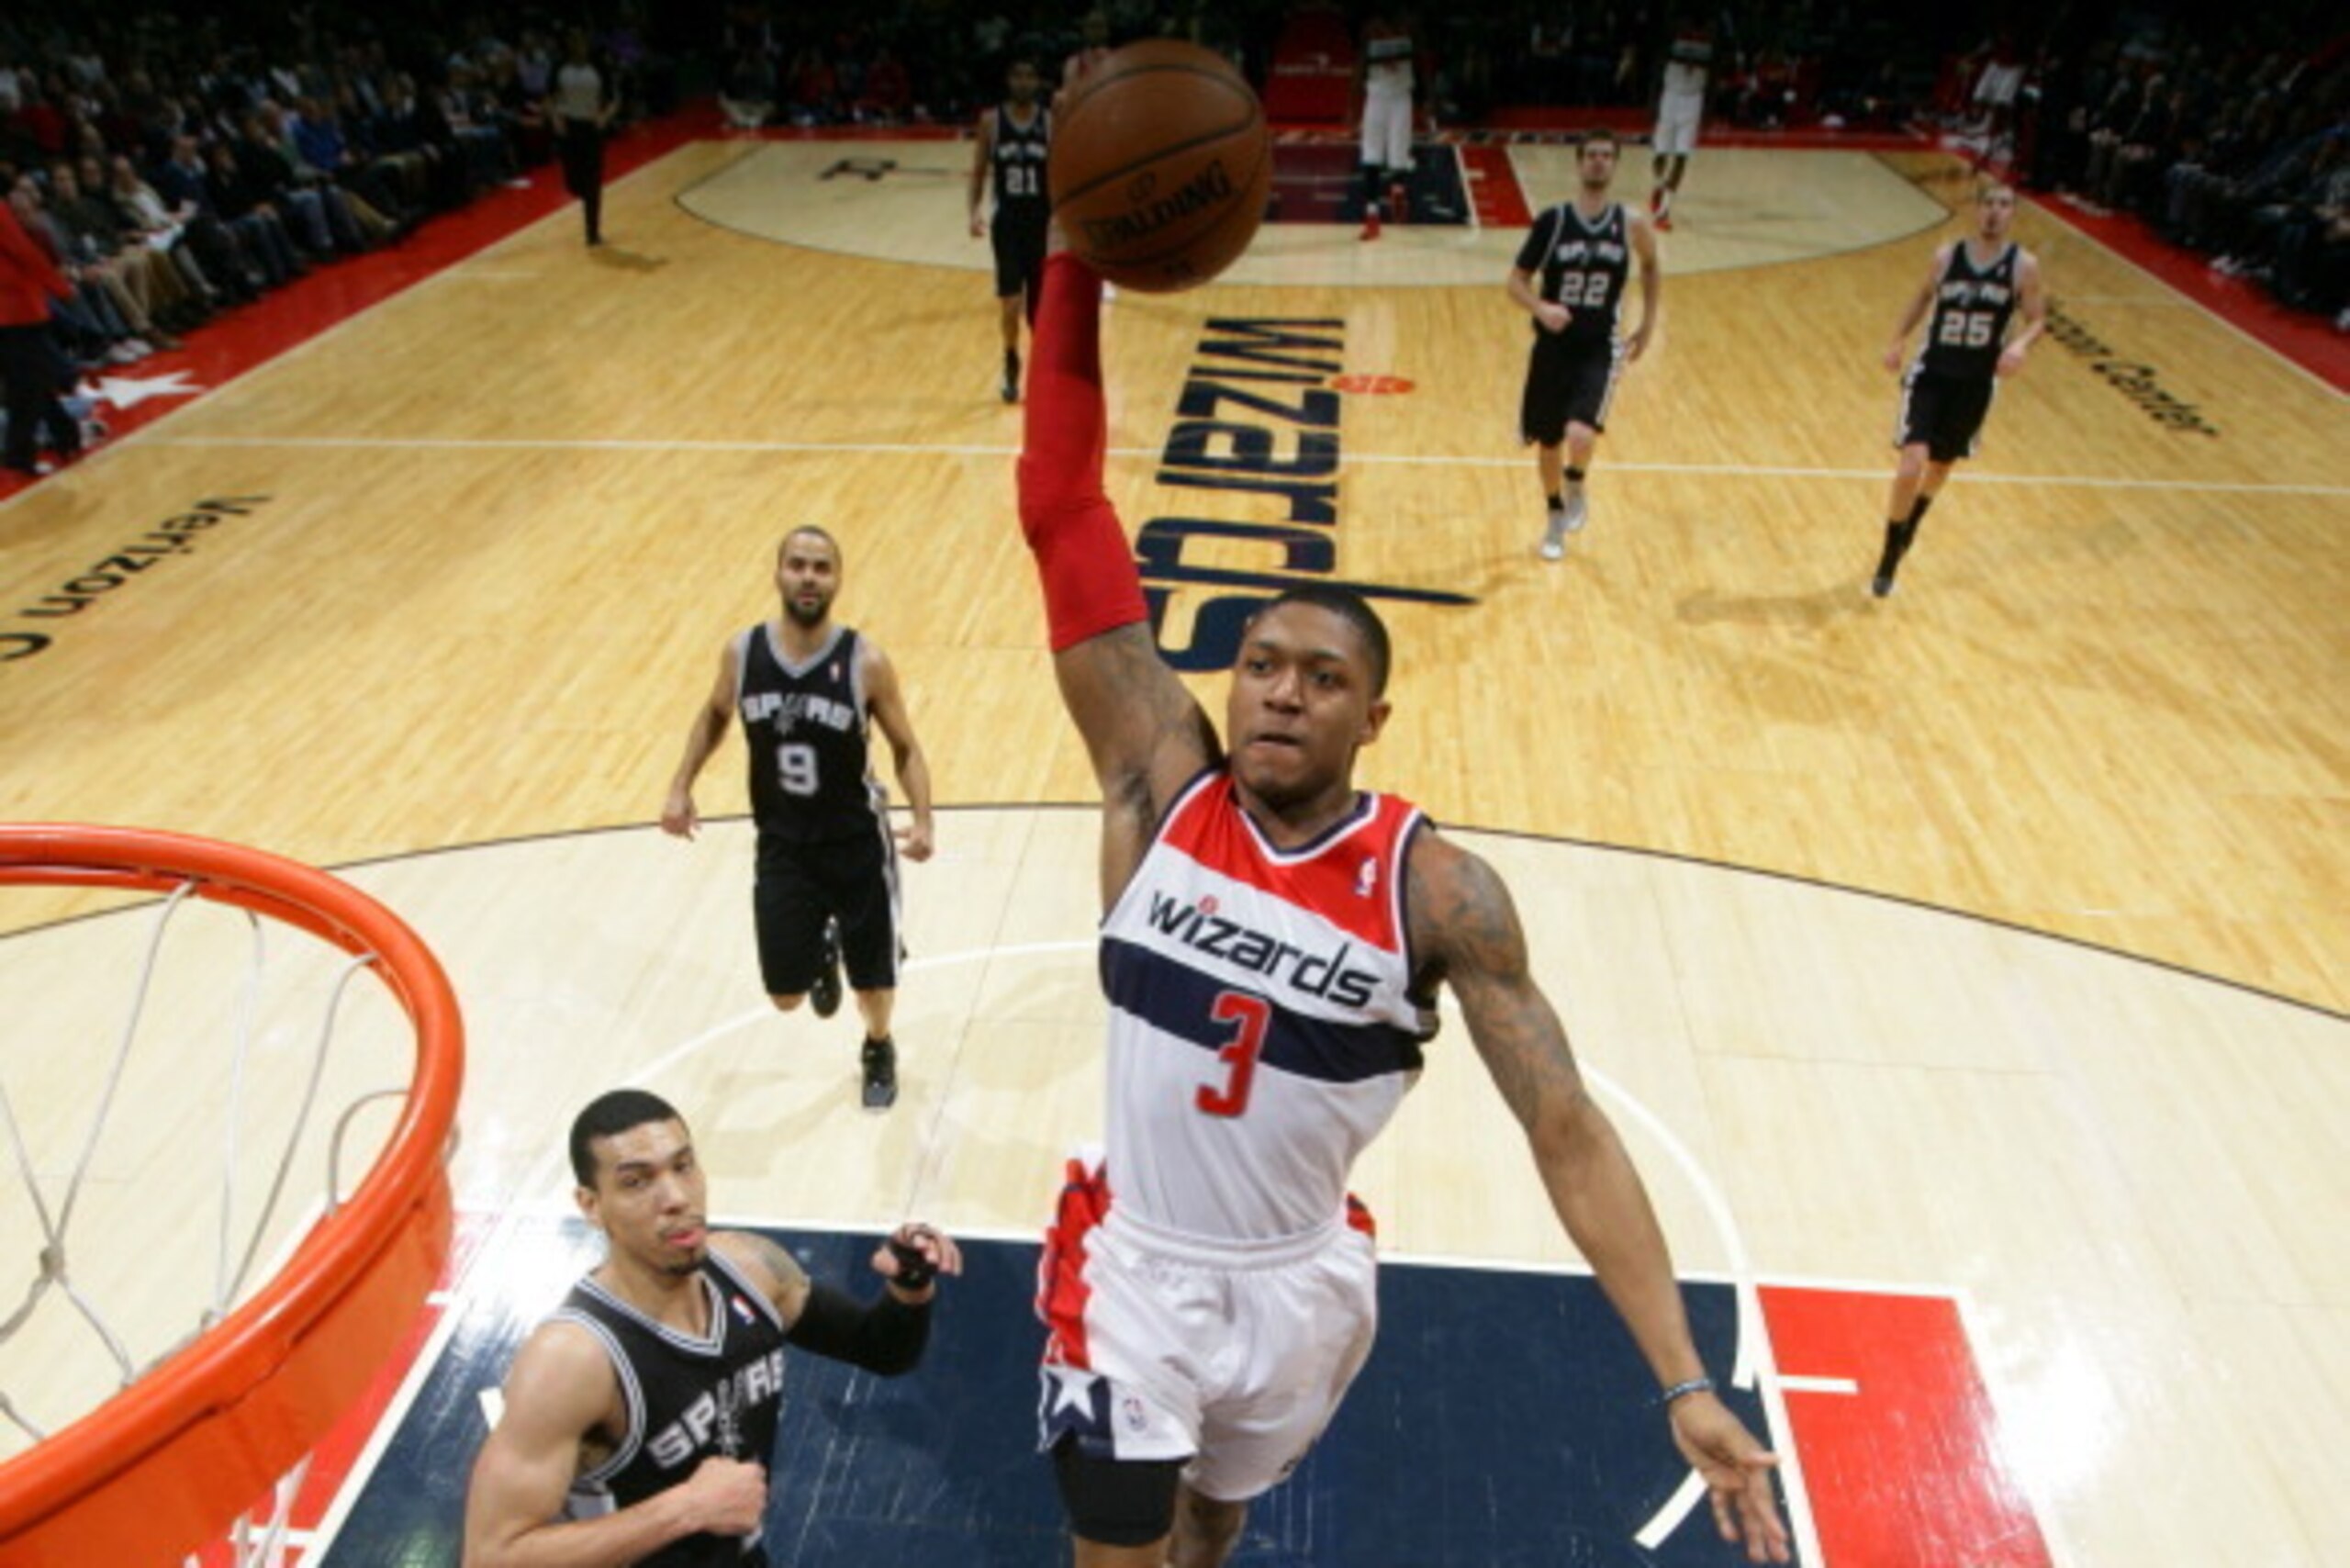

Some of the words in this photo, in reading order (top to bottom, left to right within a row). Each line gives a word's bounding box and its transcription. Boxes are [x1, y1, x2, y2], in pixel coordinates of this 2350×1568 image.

[1006, 167, 1037, 195] 21
[1080, 158, 1229, 253] SPALDING
[1561, 271, 1610, 306] 22
[1940, 311, 1993, 346] 25
[17, 496, 274, 617] Verizon
[743, 692, 856, 733] SPURS
[778, 744, 818, 796] 9
[1147, 890, 1383, 1009] wizards
[1195, 990, 1270, 1117] 3
